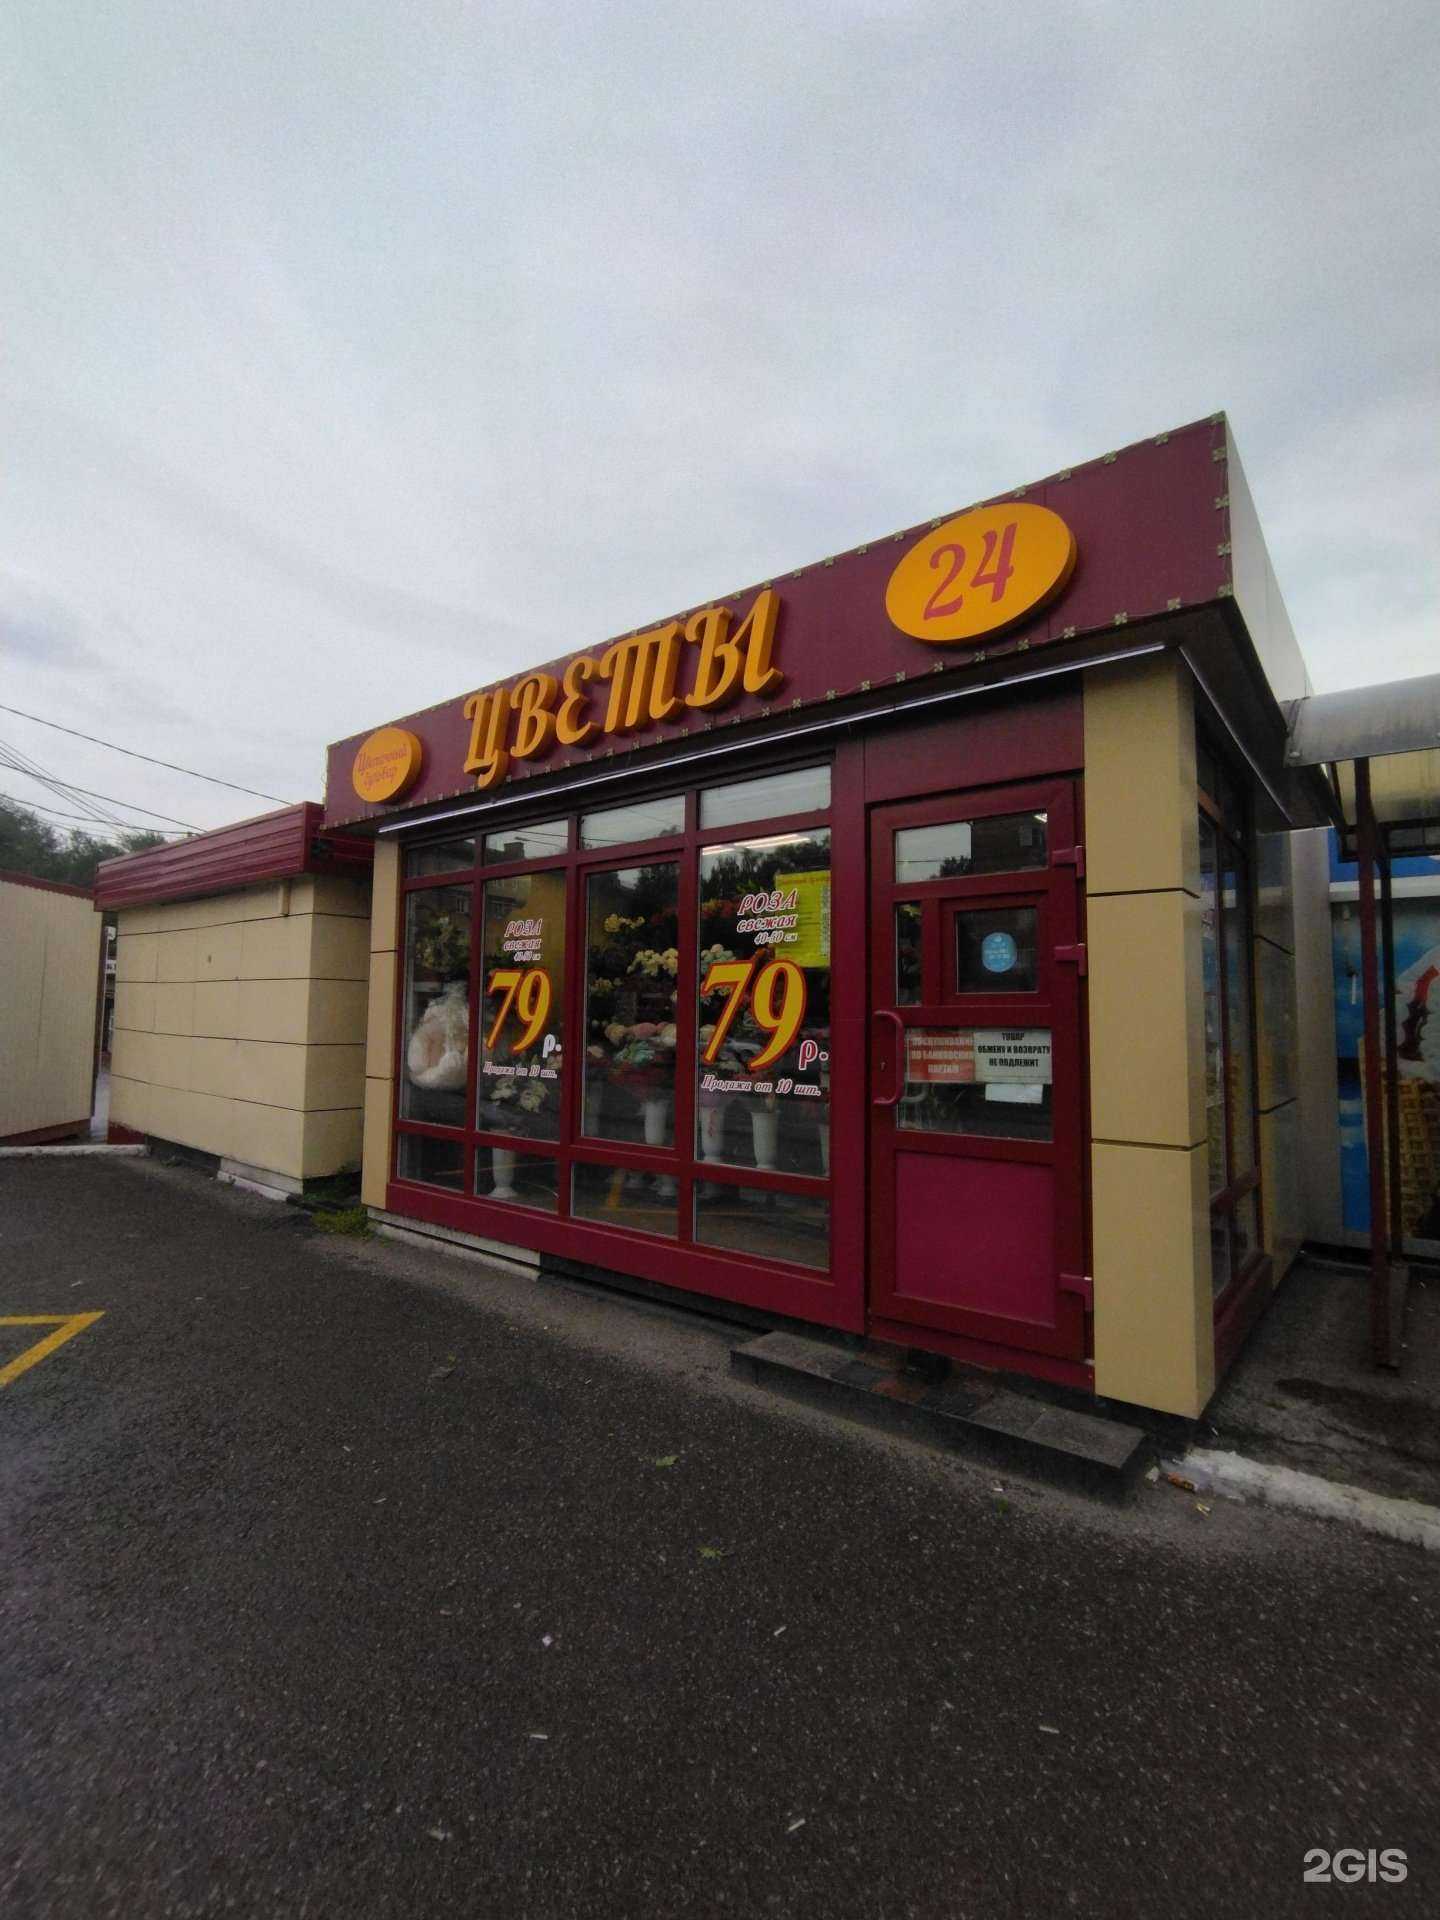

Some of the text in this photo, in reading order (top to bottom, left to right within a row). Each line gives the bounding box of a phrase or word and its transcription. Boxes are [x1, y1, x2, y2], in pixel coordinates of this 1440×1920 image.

[922, 521, 1018, 621] 24
[463, 588, 784, 790] ЦВЕТЫ
[737, 888, 798, 916] РОЗА
[504, 919, 543, 937] РОЗА
[736, 914, 798, 933] свежая
[486, 969, 553, 1054] 79
[700, 958, 807, 1073] 79
[798, 1040, 829, 1071] р.
[754, 1082, 772, 1093] от
[775, 1079, 792, 1094] 10
